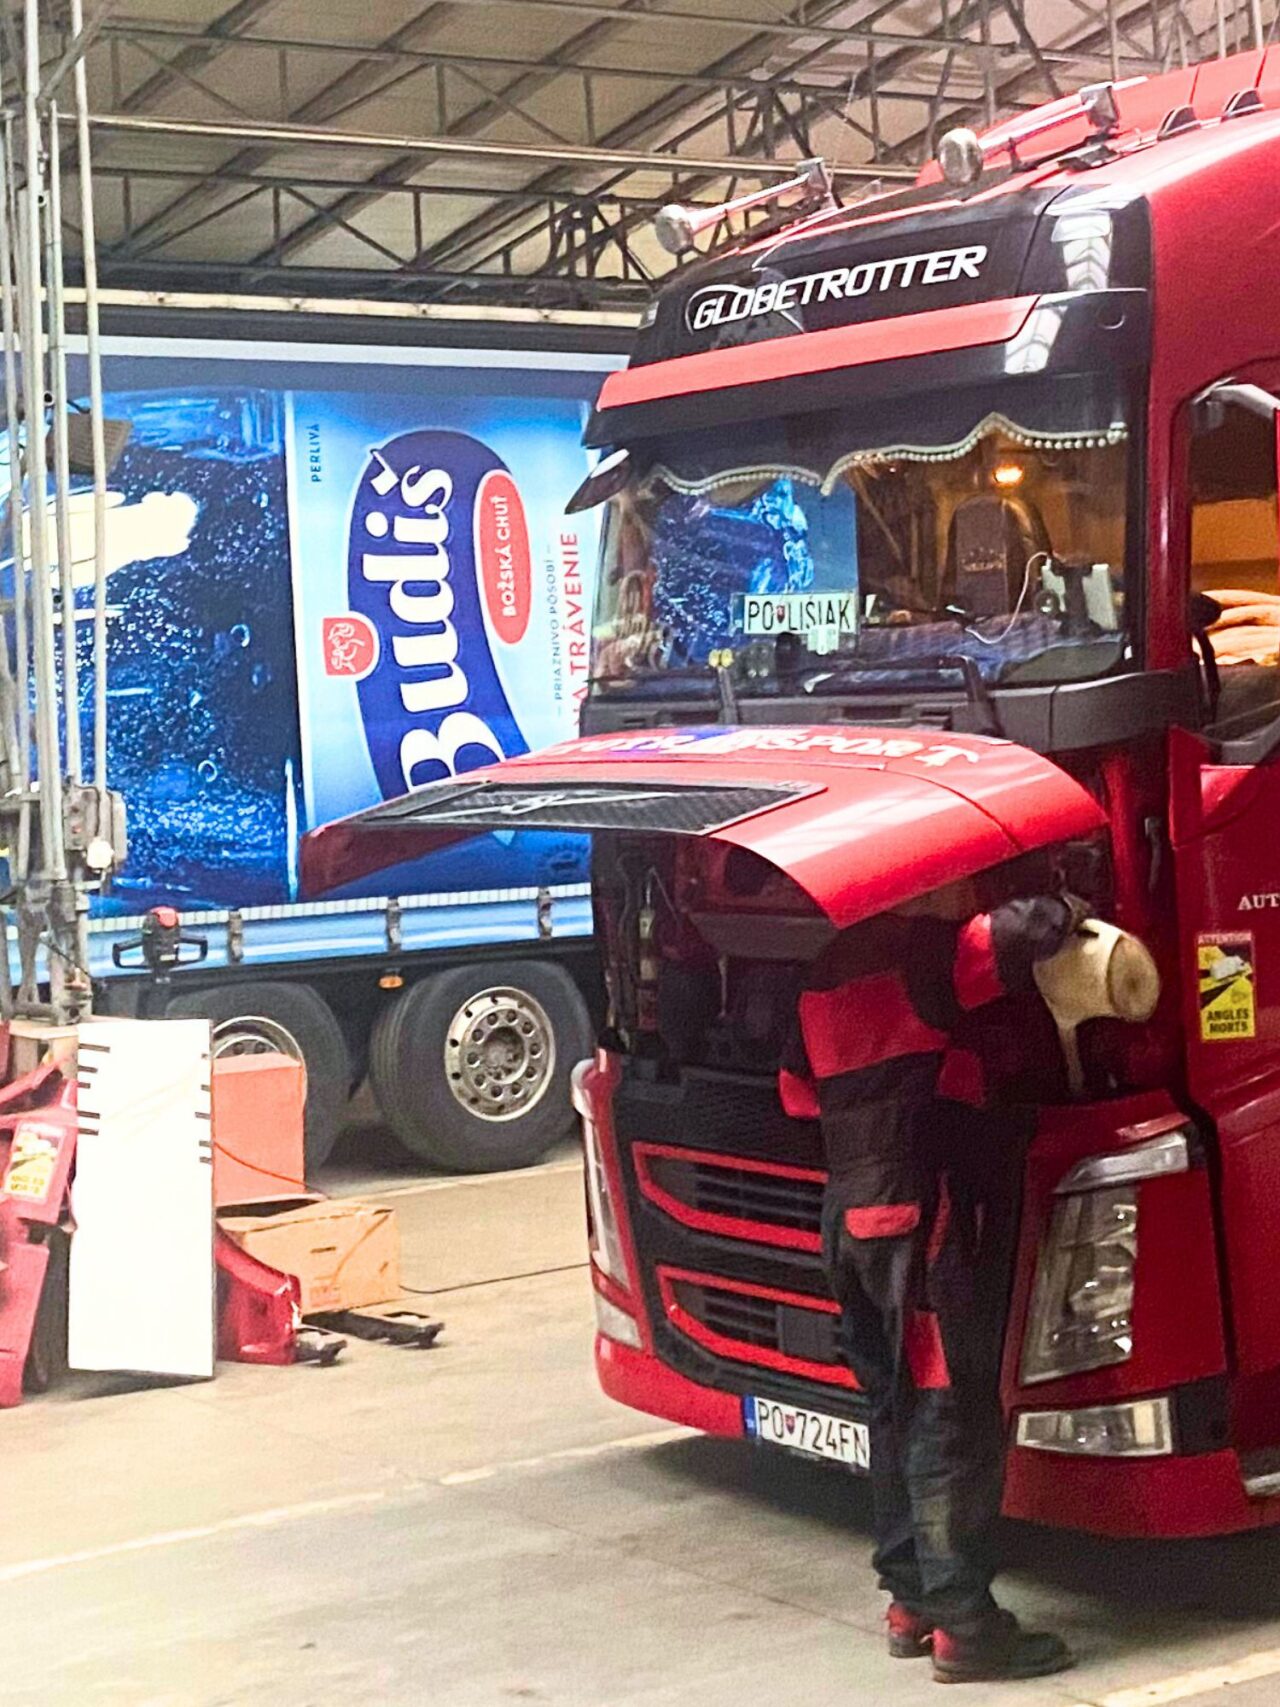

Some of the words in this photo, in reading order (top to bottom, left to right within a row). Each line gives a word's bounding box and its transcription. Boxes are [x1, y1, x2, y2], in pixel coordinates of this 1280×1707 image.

[692, 244, 988, 331] GLOBETROTTER
[305, 423, 322, 483] PERLIVÁ
[494, 543, 518, 618] BOŽSKÁ
[560, 532, 588, 677] TRÁVENIE
[362, 448, 505, 794] Budiš
[748, 600, 775, 631] PO
[549, 619, 563, 701] PRIAZNIVO
[1206, 1008, 1249, 1020] ANGLES
[1208, 1021, 1249, 1033] MORTS
[757, 1401, 785, 1439] PO
[795, 1411, 868, 1464] 724FN
